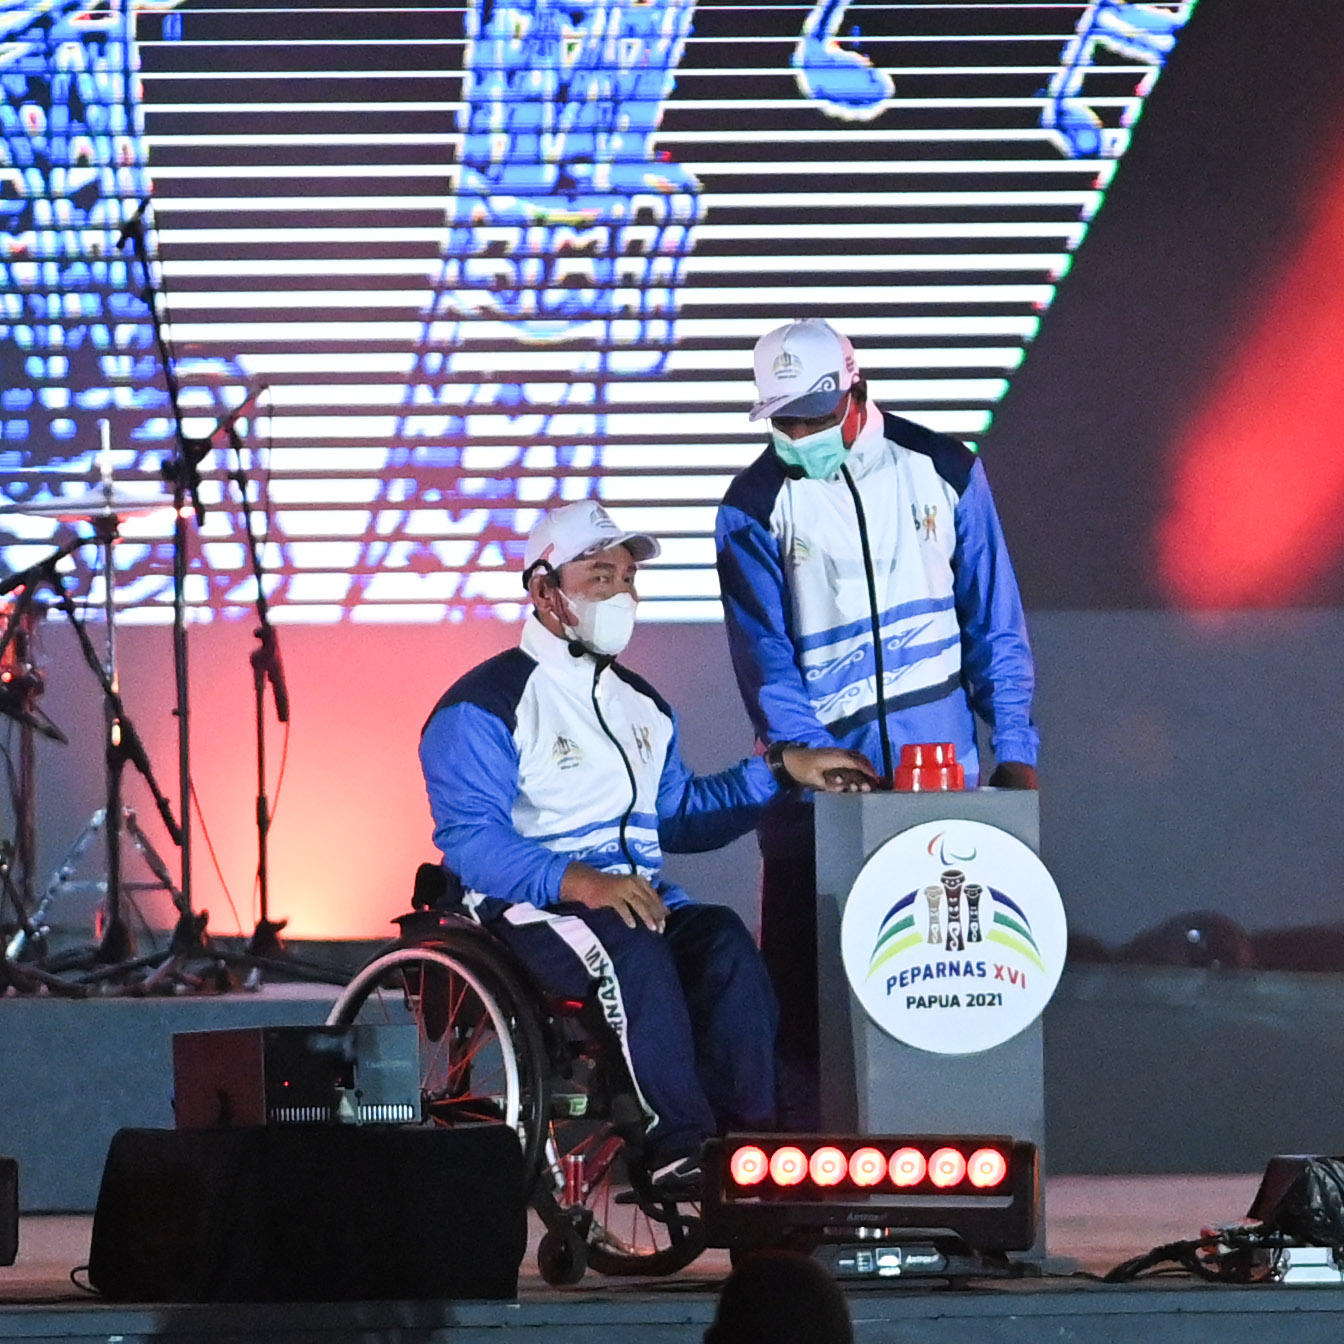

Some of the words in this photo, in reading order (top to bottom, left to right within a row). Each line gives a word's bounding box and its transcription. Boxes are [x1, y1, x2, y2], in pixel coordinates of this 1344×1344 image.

[584, 944, 610, 976] XVI
[886, 960, 987, 996] PEPARNAS
[993, 963, 1027, 989] XVI
[906, 994, 961, 1010] PAPUA
[966, 992, 1003, 1008] 2021
